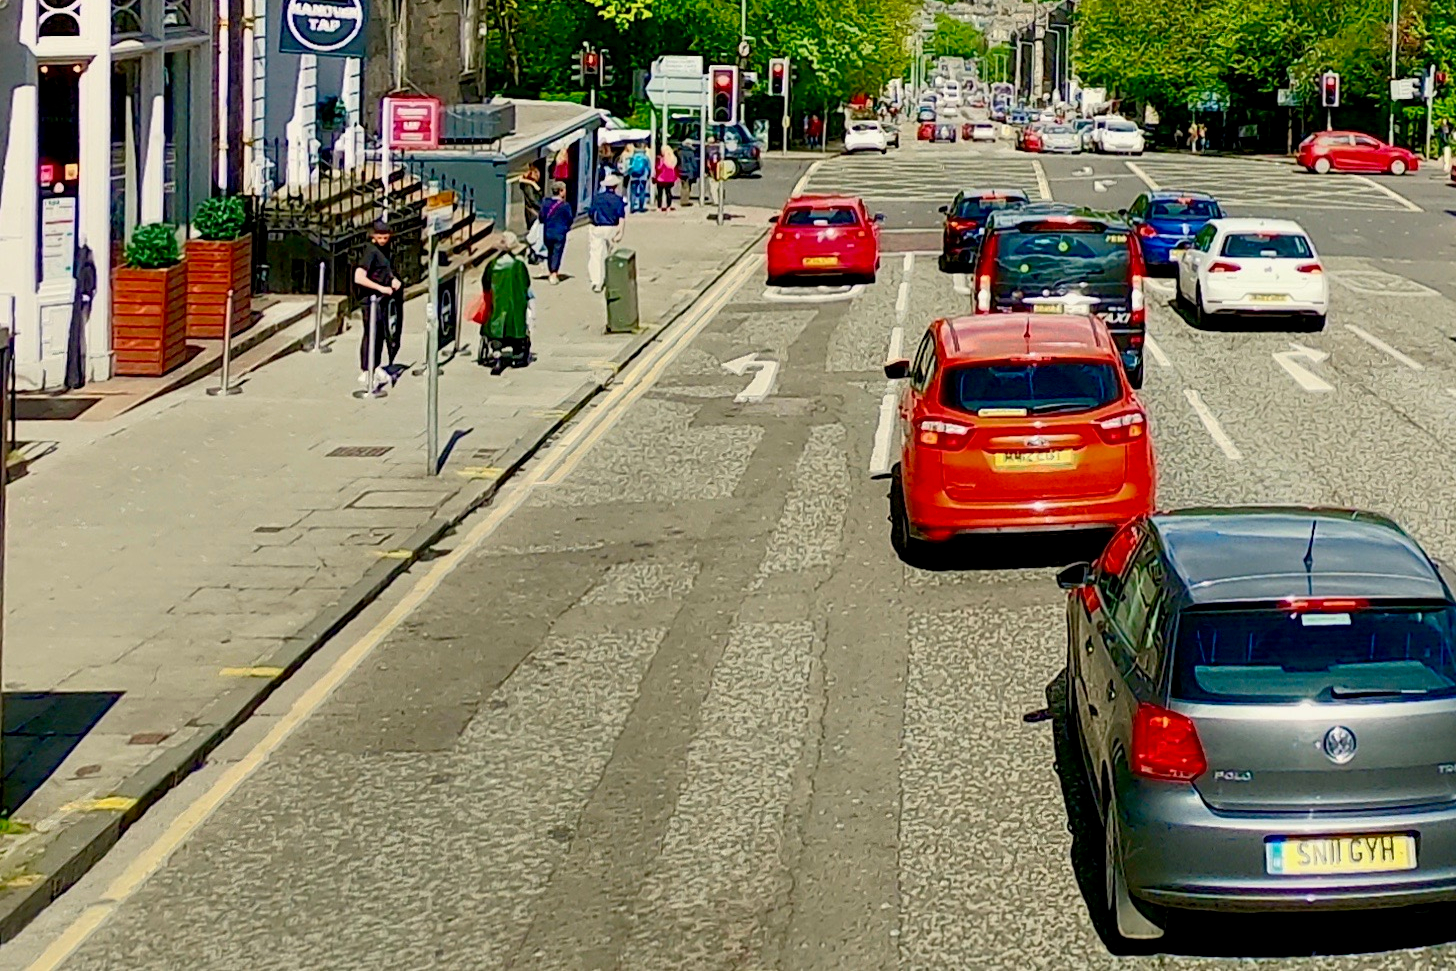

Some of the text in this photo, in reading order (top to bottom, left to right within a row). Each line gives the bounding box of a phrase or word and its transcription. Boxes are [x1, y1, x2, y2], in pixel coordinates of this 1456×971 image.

[291, 1, 359, 21] HANOVER
[307, 18, 341, 32] TAP
[1213, 770, 1252, 781] POLO
[1349, 836, 1395, 863] GYH
